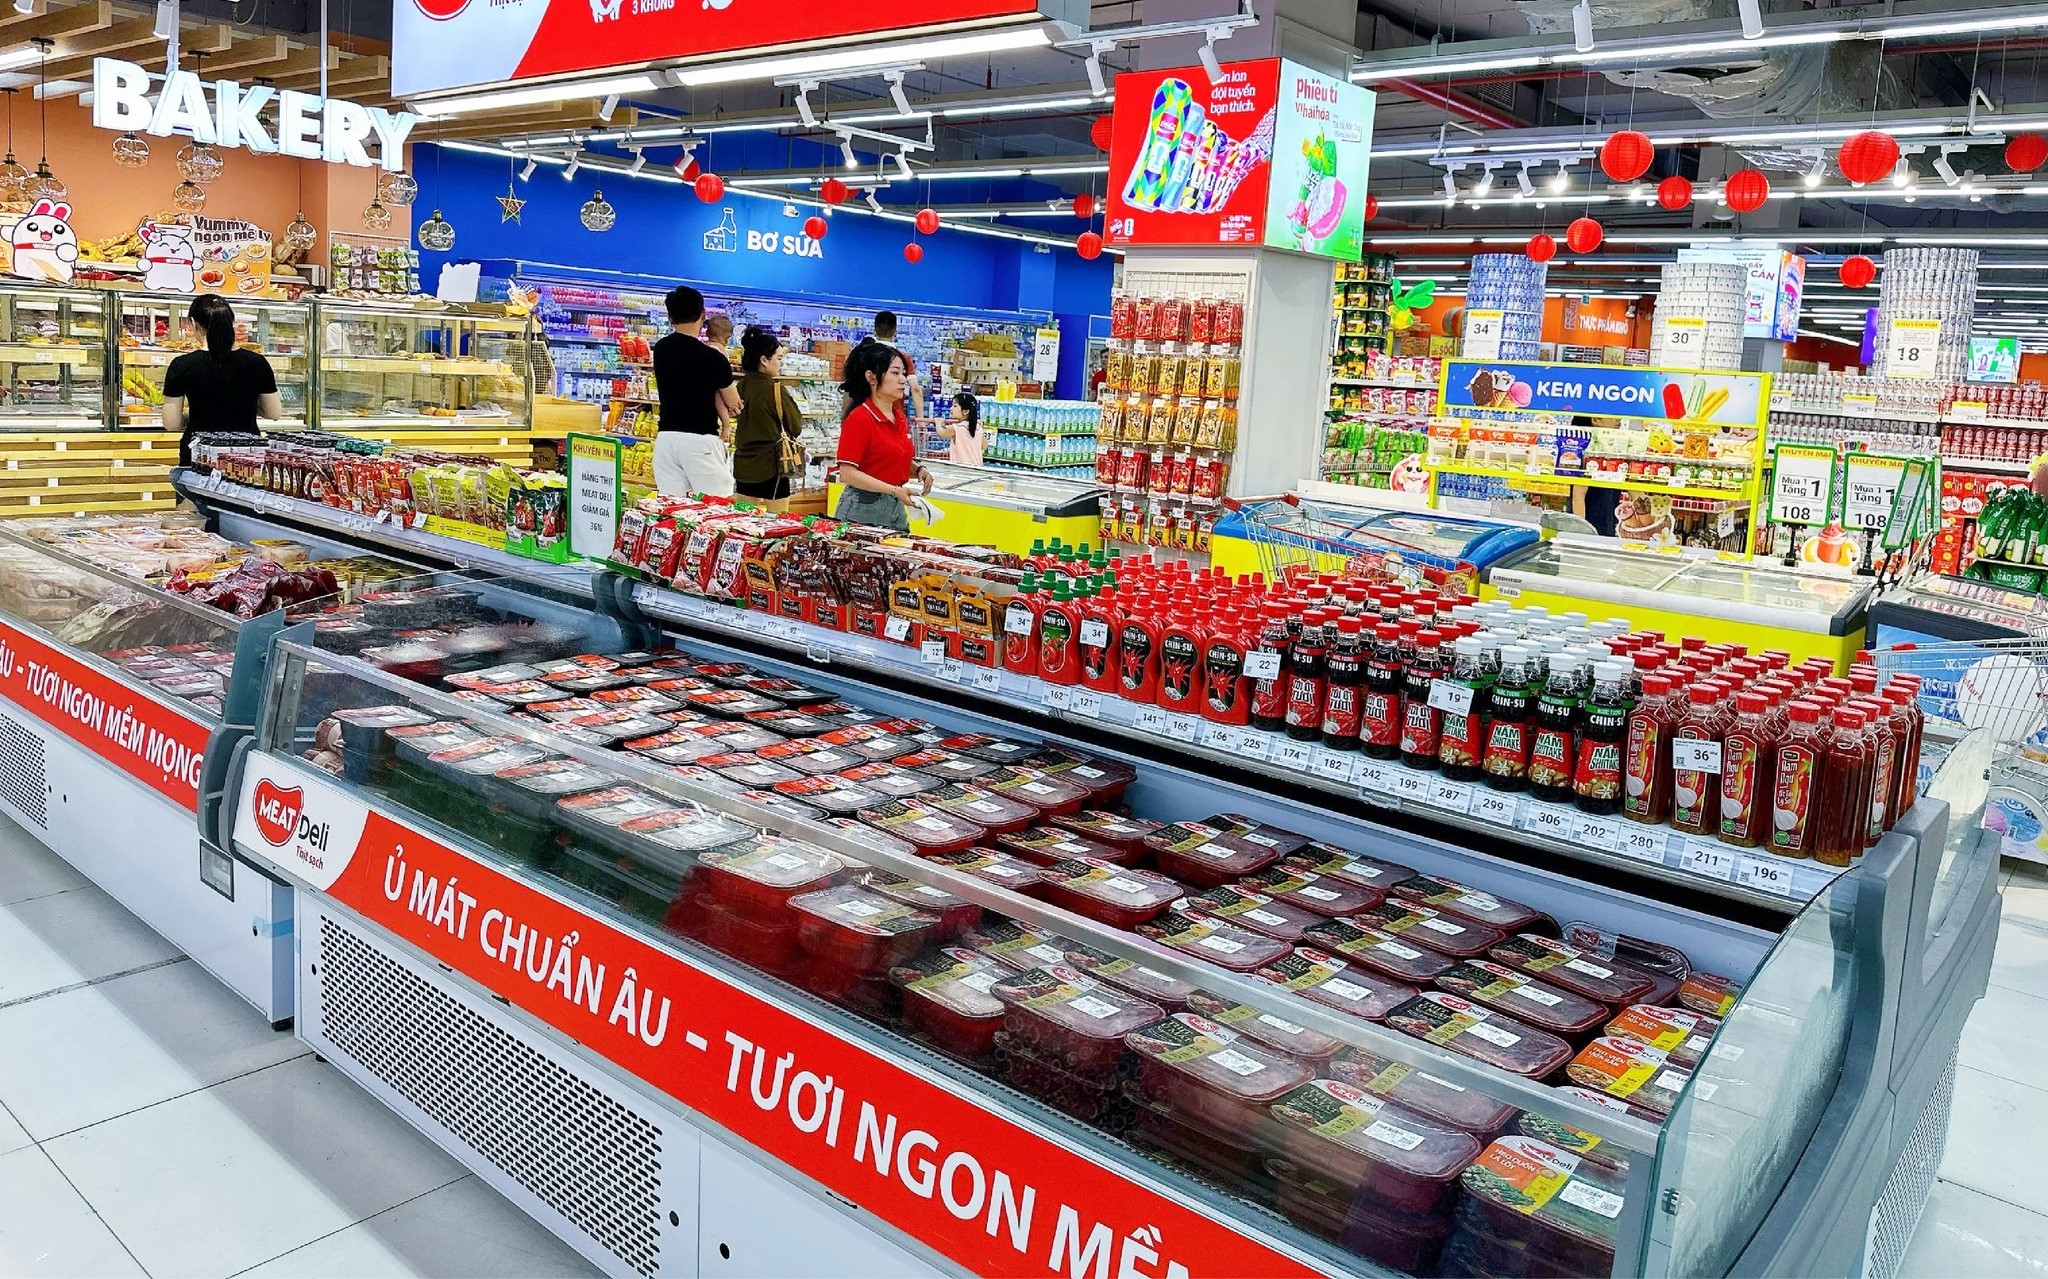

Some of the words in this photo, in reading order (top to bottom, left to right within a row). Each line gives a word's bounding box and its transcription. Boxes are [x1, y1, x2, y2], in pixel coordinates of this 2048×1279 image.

[1231, 71, 1247, 82] lon
[1211, 87, 1228, 101] đội
[93, 56, 417, 173] BAKERY
[1210, 102, 1228, 116] bạn
[194, 215, 250, 234] Yummy
[194, 231, 238, 243] ngon
[258, 232, 272, 243] ly
[747, 230, 779, 253] BƠ
[1473, 324, 1489, 334] 34
[1671, 332, 1689, 344] 30
[1040, 344, 1050, 355] 28
[1897, 347, 1919, 362] 18
[1537, 381, 1583, 399] KEM
[1588, 383, 1655, 404] NGON
[573, 443, 601, 456] KHUYẾN
[581, 472, 599, 484] HÀNG
[599, 475, 614, 486] THỊT
[1782, 477, 1800, 485] Mua
[581, 488, 598, 499] MEAT
[599, 491, 612, 501] DELI
[1782, 485, 1807, 496] Tặng
[1811, 480, 1821, 497] 1
[1854, 485, 1874, 493] Mua
[1854, 493, 1881, 505] Tặng
[581, 503, 599, 515] GIẢM
[599, 506, 610, 518] GIÁ
[1781, 506, 1810, 520] 108
[590, 521, 603, 532] 36%
[1855, 513, 1887, 527] 108
[1017, 617, 1026, 626] 34
[1092, 629, 1100, 638] 34
[1259, 660, 1271, 669] 22
[1328, 659, 1359, 672] CHIN-SU
[1407, 675, 1430, 687] CHIN-S
[1050, 690, 1064, 701] 162
[1448, 692, 1461, 703] 19
[1492, 694, 1525, 708] CHIN-SU
[26, 660, 59, 702] TƯƠI
[61, 687, 102, 732] NGON
[104, 704, 143, 755] MỀM
[149, 727, 203, 782] MỌNG
[1142, 712, 1157, 723] 141
[1173, 721, 1188, 732] 165
[1243, 738, 1260, 749] 225
[1284, 748, 1300, 759] 174
[1693, 749, 1709, 761] 36
[1324, 759, 1342, 770] 182
[1361, 768, 1381, 780] 242
[1399, 778, 1418, 790] 199
[1438, 788, 1460, 800] 287
[1482, 798, 1504, 811] 299
[258, 793, 296, 833] MEAT
[1538, 812, 1561, 826] 306
[298, 814, 330, 852] Deli
[1583, 823, 1606, 838] 202
[1630, 834, 1653, 848] 280
[295, 844, 308, 863] Thịt
[308, 853, 324, 870] sạch
[1695, 851, 1719, 867] 211
[1754, 866, 1778, 881] 196
[1644, 1006, 1672, 1020] MEAT
[1673, 1018, 1692, 1028] Deli
[383, 844, 405, 901] Ủ
[408, 868, 477, 940] MÁT
[479, 908, 605, 1015] CHUẨN
[609, 967, 672, 1048] ÂU
[724, 1030, 845, 1149] TƯƠI
[853, 1100, 1037, 1254] NGON
[1048, 1203, 1190, 1279] MỀ
[1551, 1158, 1573, 1171] Deli
